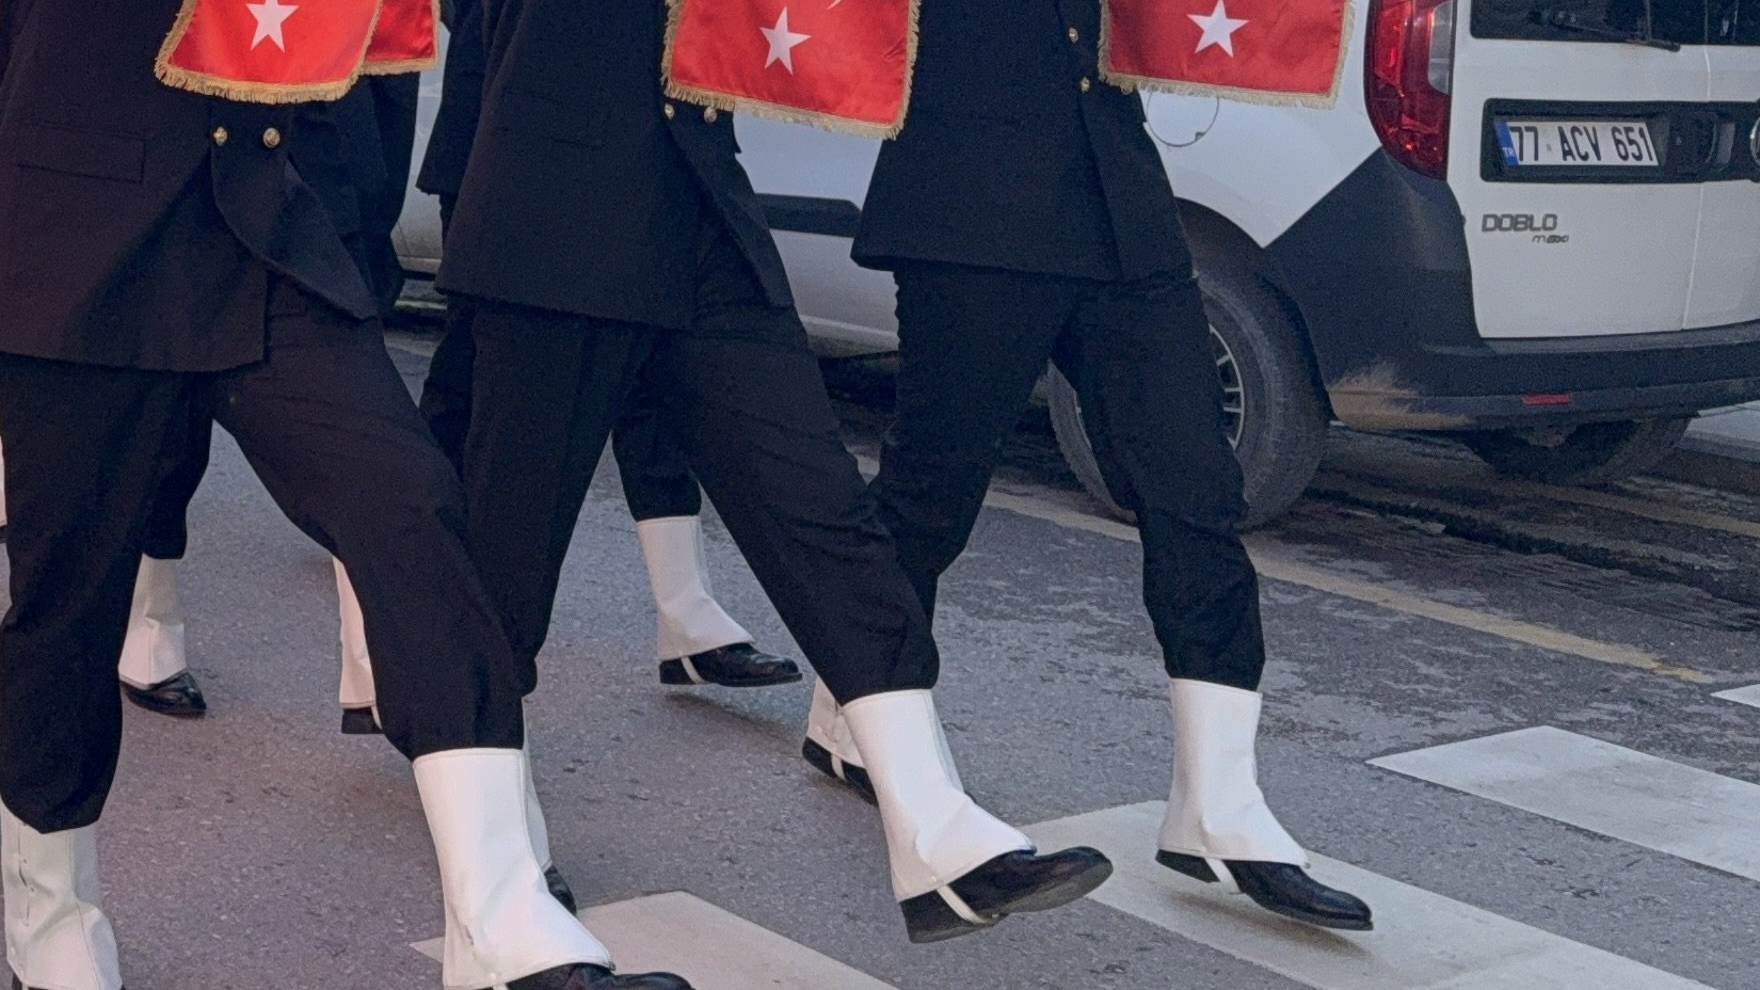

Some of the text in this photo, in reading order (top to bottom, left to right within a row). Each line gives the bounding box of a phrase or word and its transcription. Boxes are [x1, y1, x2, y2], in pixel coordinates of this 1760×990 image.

[1509, 125, 1654, 162] 77 ACV 651
[1481, 213, 1558, 232] DOBLO
